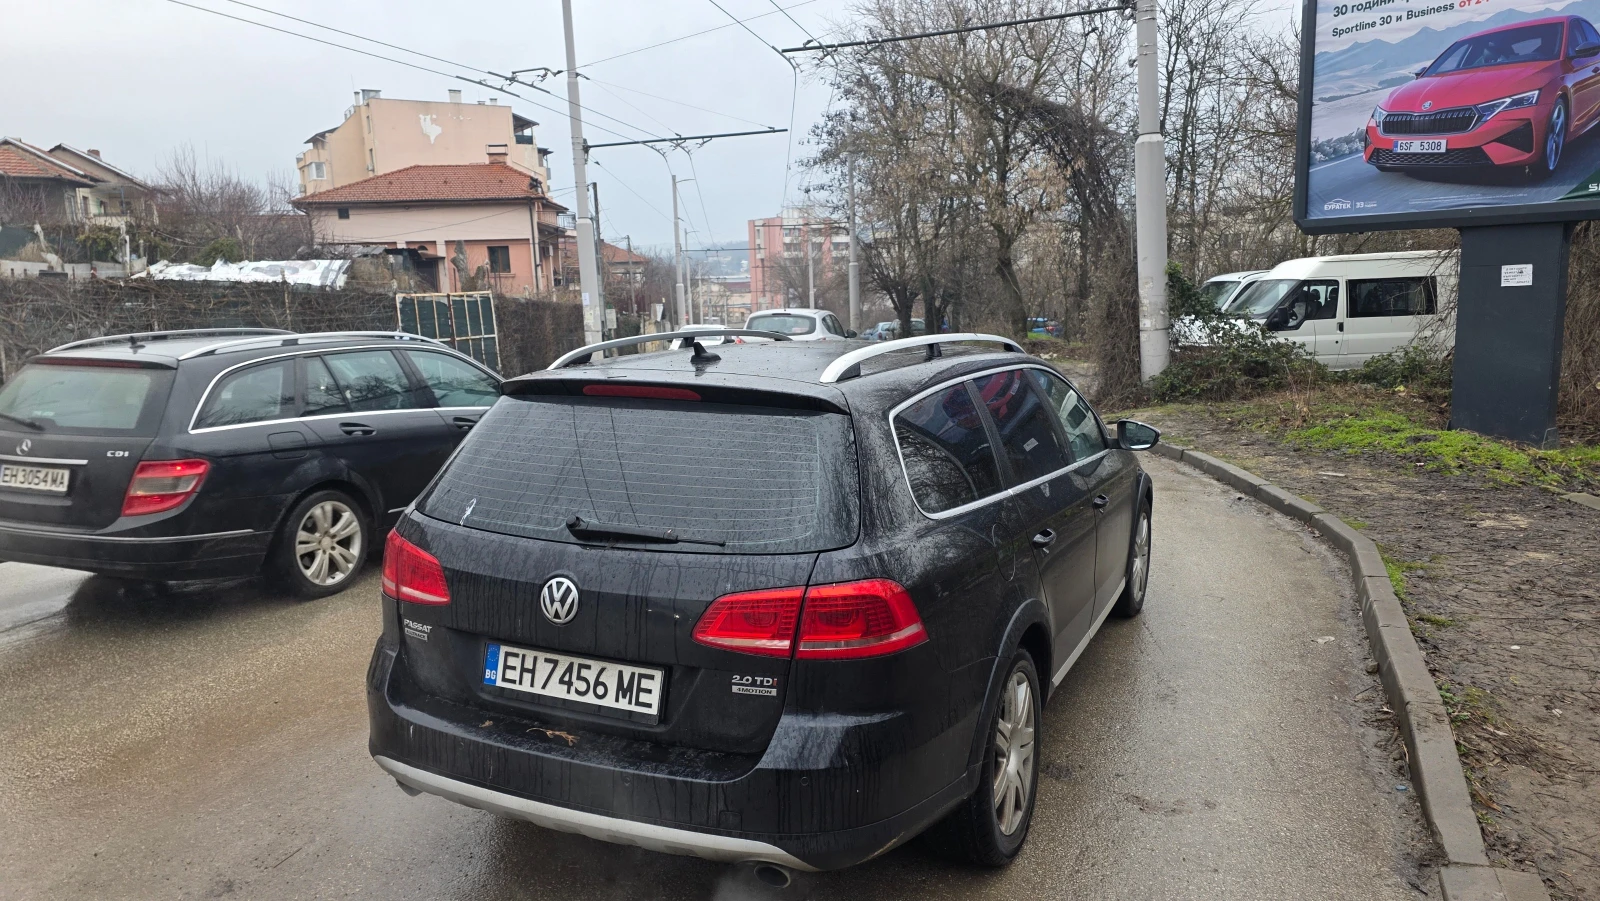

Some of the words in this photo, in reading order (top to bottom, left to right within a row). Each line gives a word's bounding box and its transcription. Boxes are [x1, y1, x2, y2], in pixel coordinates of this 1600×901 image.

[1333, 4, 1348, 17] 30
[1332, 20, 1377, 38] Sportline
[1379, 15, 1392, 26] 30
[1406, 2, 1455, 20] Business
[1399, 141, 1414, 151] 6SF
[1420, 141, 1442, 151] 5308
[1588, 183, 1600, 191] S
[404, 619, 433, 633] PASSAT
[485, 669, 496, 680] BG
[737, 687, 772, 695] 4MOTION
